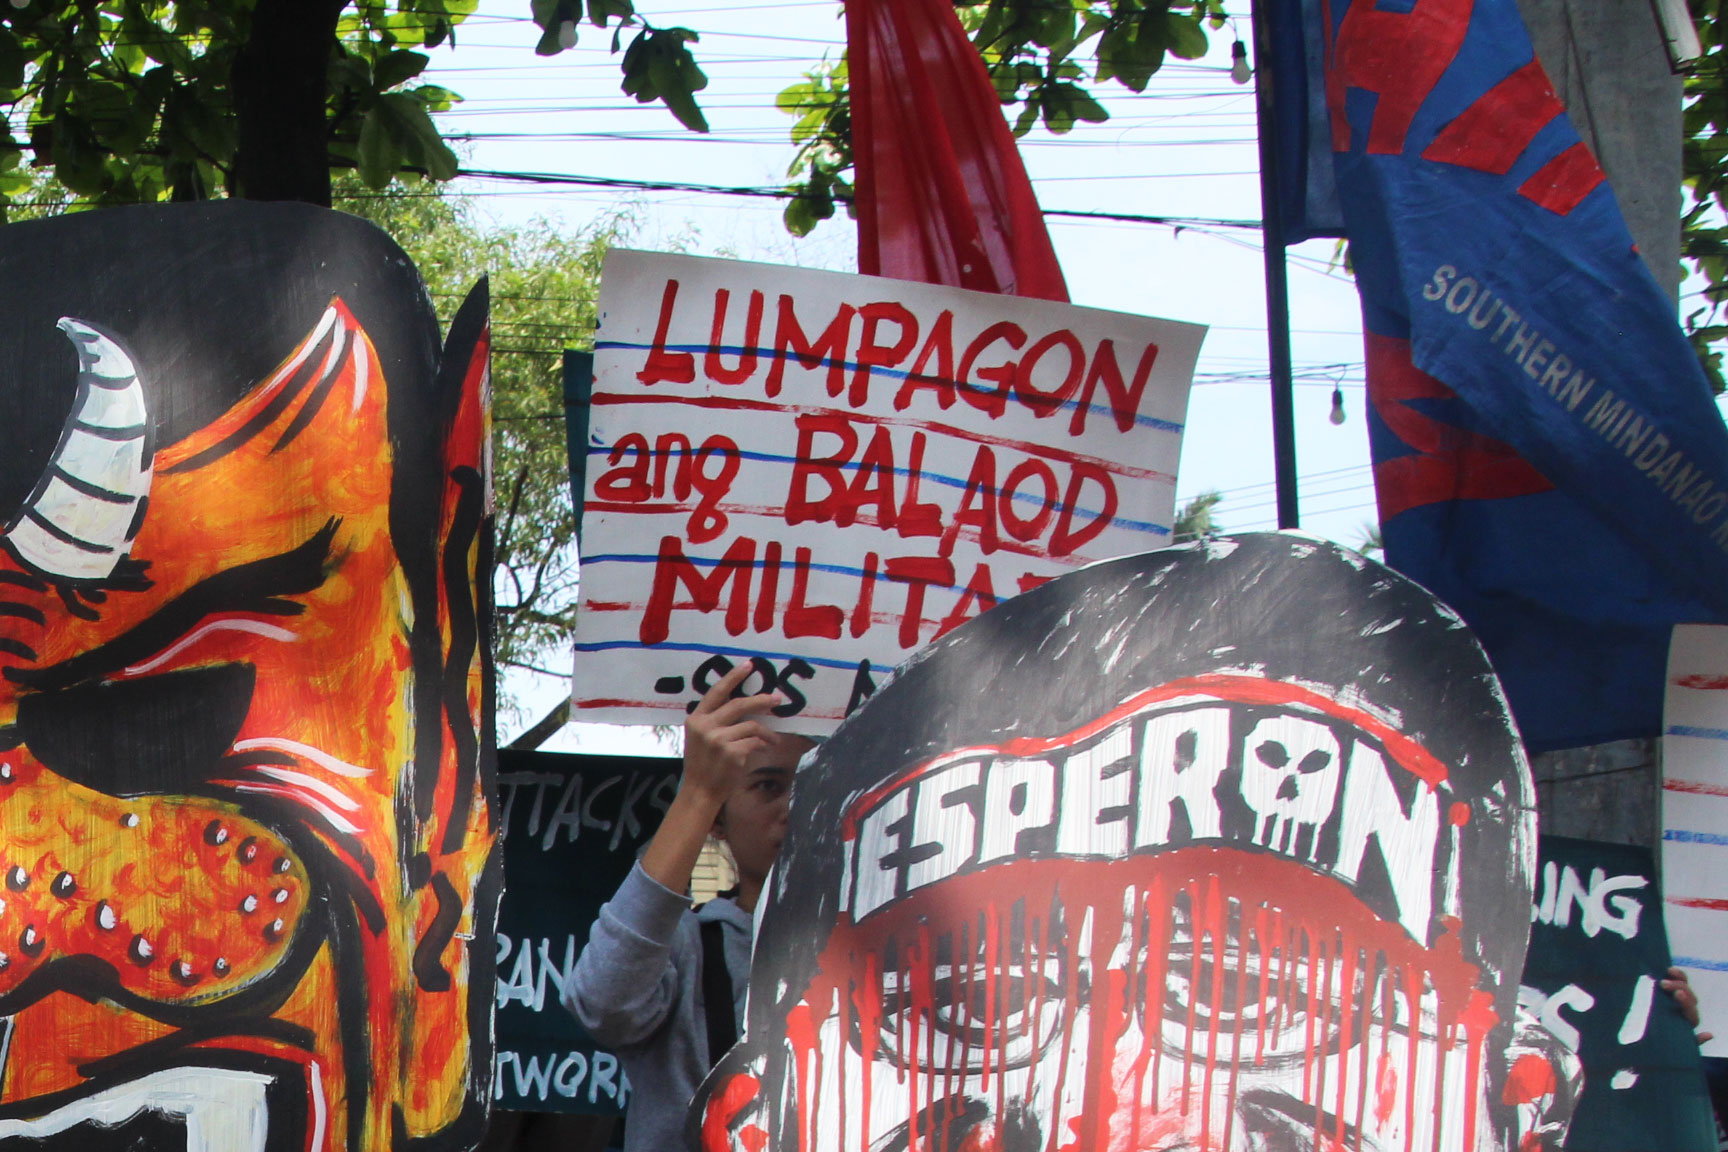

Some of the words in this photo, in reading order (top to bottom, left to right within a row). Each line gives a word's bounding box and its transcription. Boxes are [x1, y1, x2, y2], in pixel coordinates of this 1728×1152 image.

[636, 279, 1159, 436] LUMPAGON
[1423, 264, 1596, 412] SOUTHERN
[1583, 390, 1727, 525] MINDANAO
[593, 431, 741, 544] ang
[783, 413, 1119, 558] BALAOD
[638, 535, 1059, 649] MILITA
[1531, 860, 1650, 939] ING
